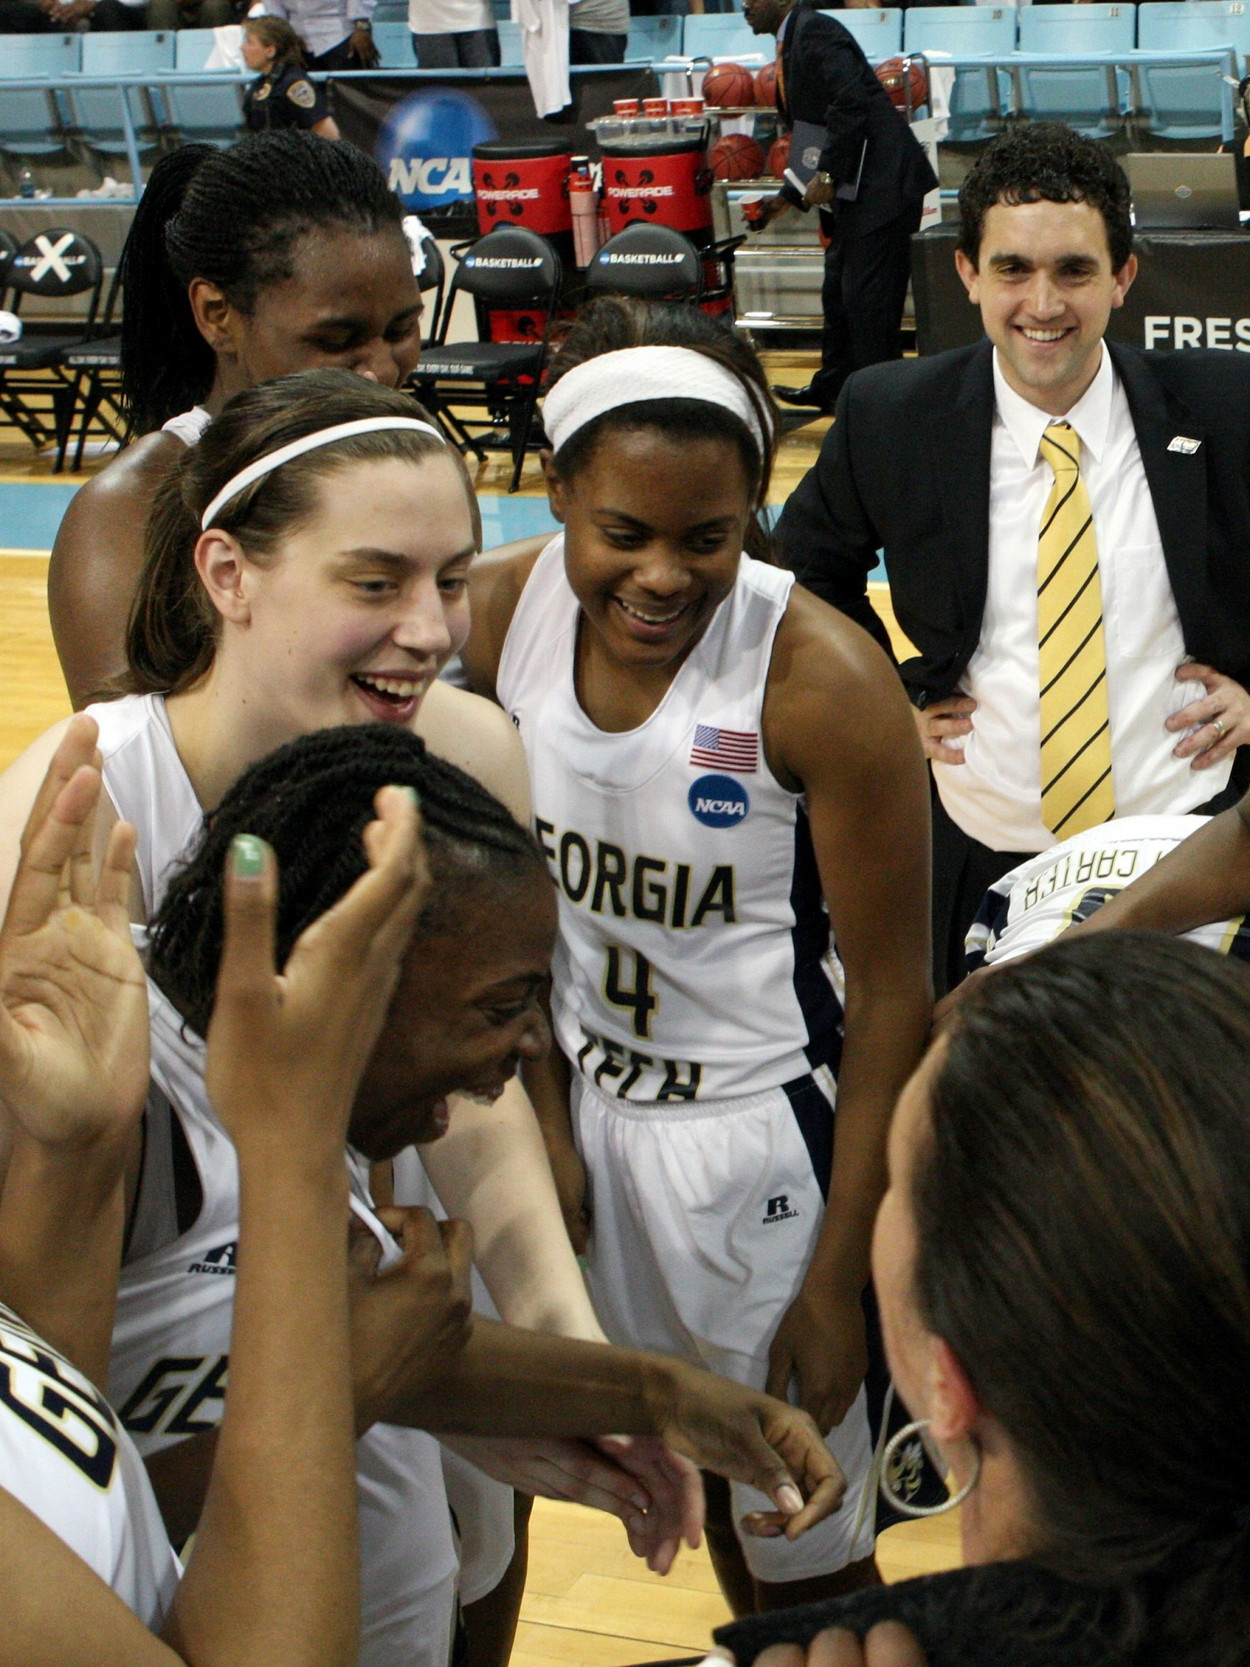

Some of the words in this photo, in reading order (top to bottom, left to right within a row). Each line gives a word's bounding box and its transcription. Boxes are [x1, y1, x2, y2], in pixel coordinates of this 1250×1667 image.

[475, 257, 535, 268] BASKETBALL
[610, 253, 675, 265] BASKETBALL
[695, 797, 745, 816] NCAA
[1023, 849, 1138, 911] CARTER
[605, 945, 656, 1038] 4
[762, 1209, 800, 1225] RUSSELL
